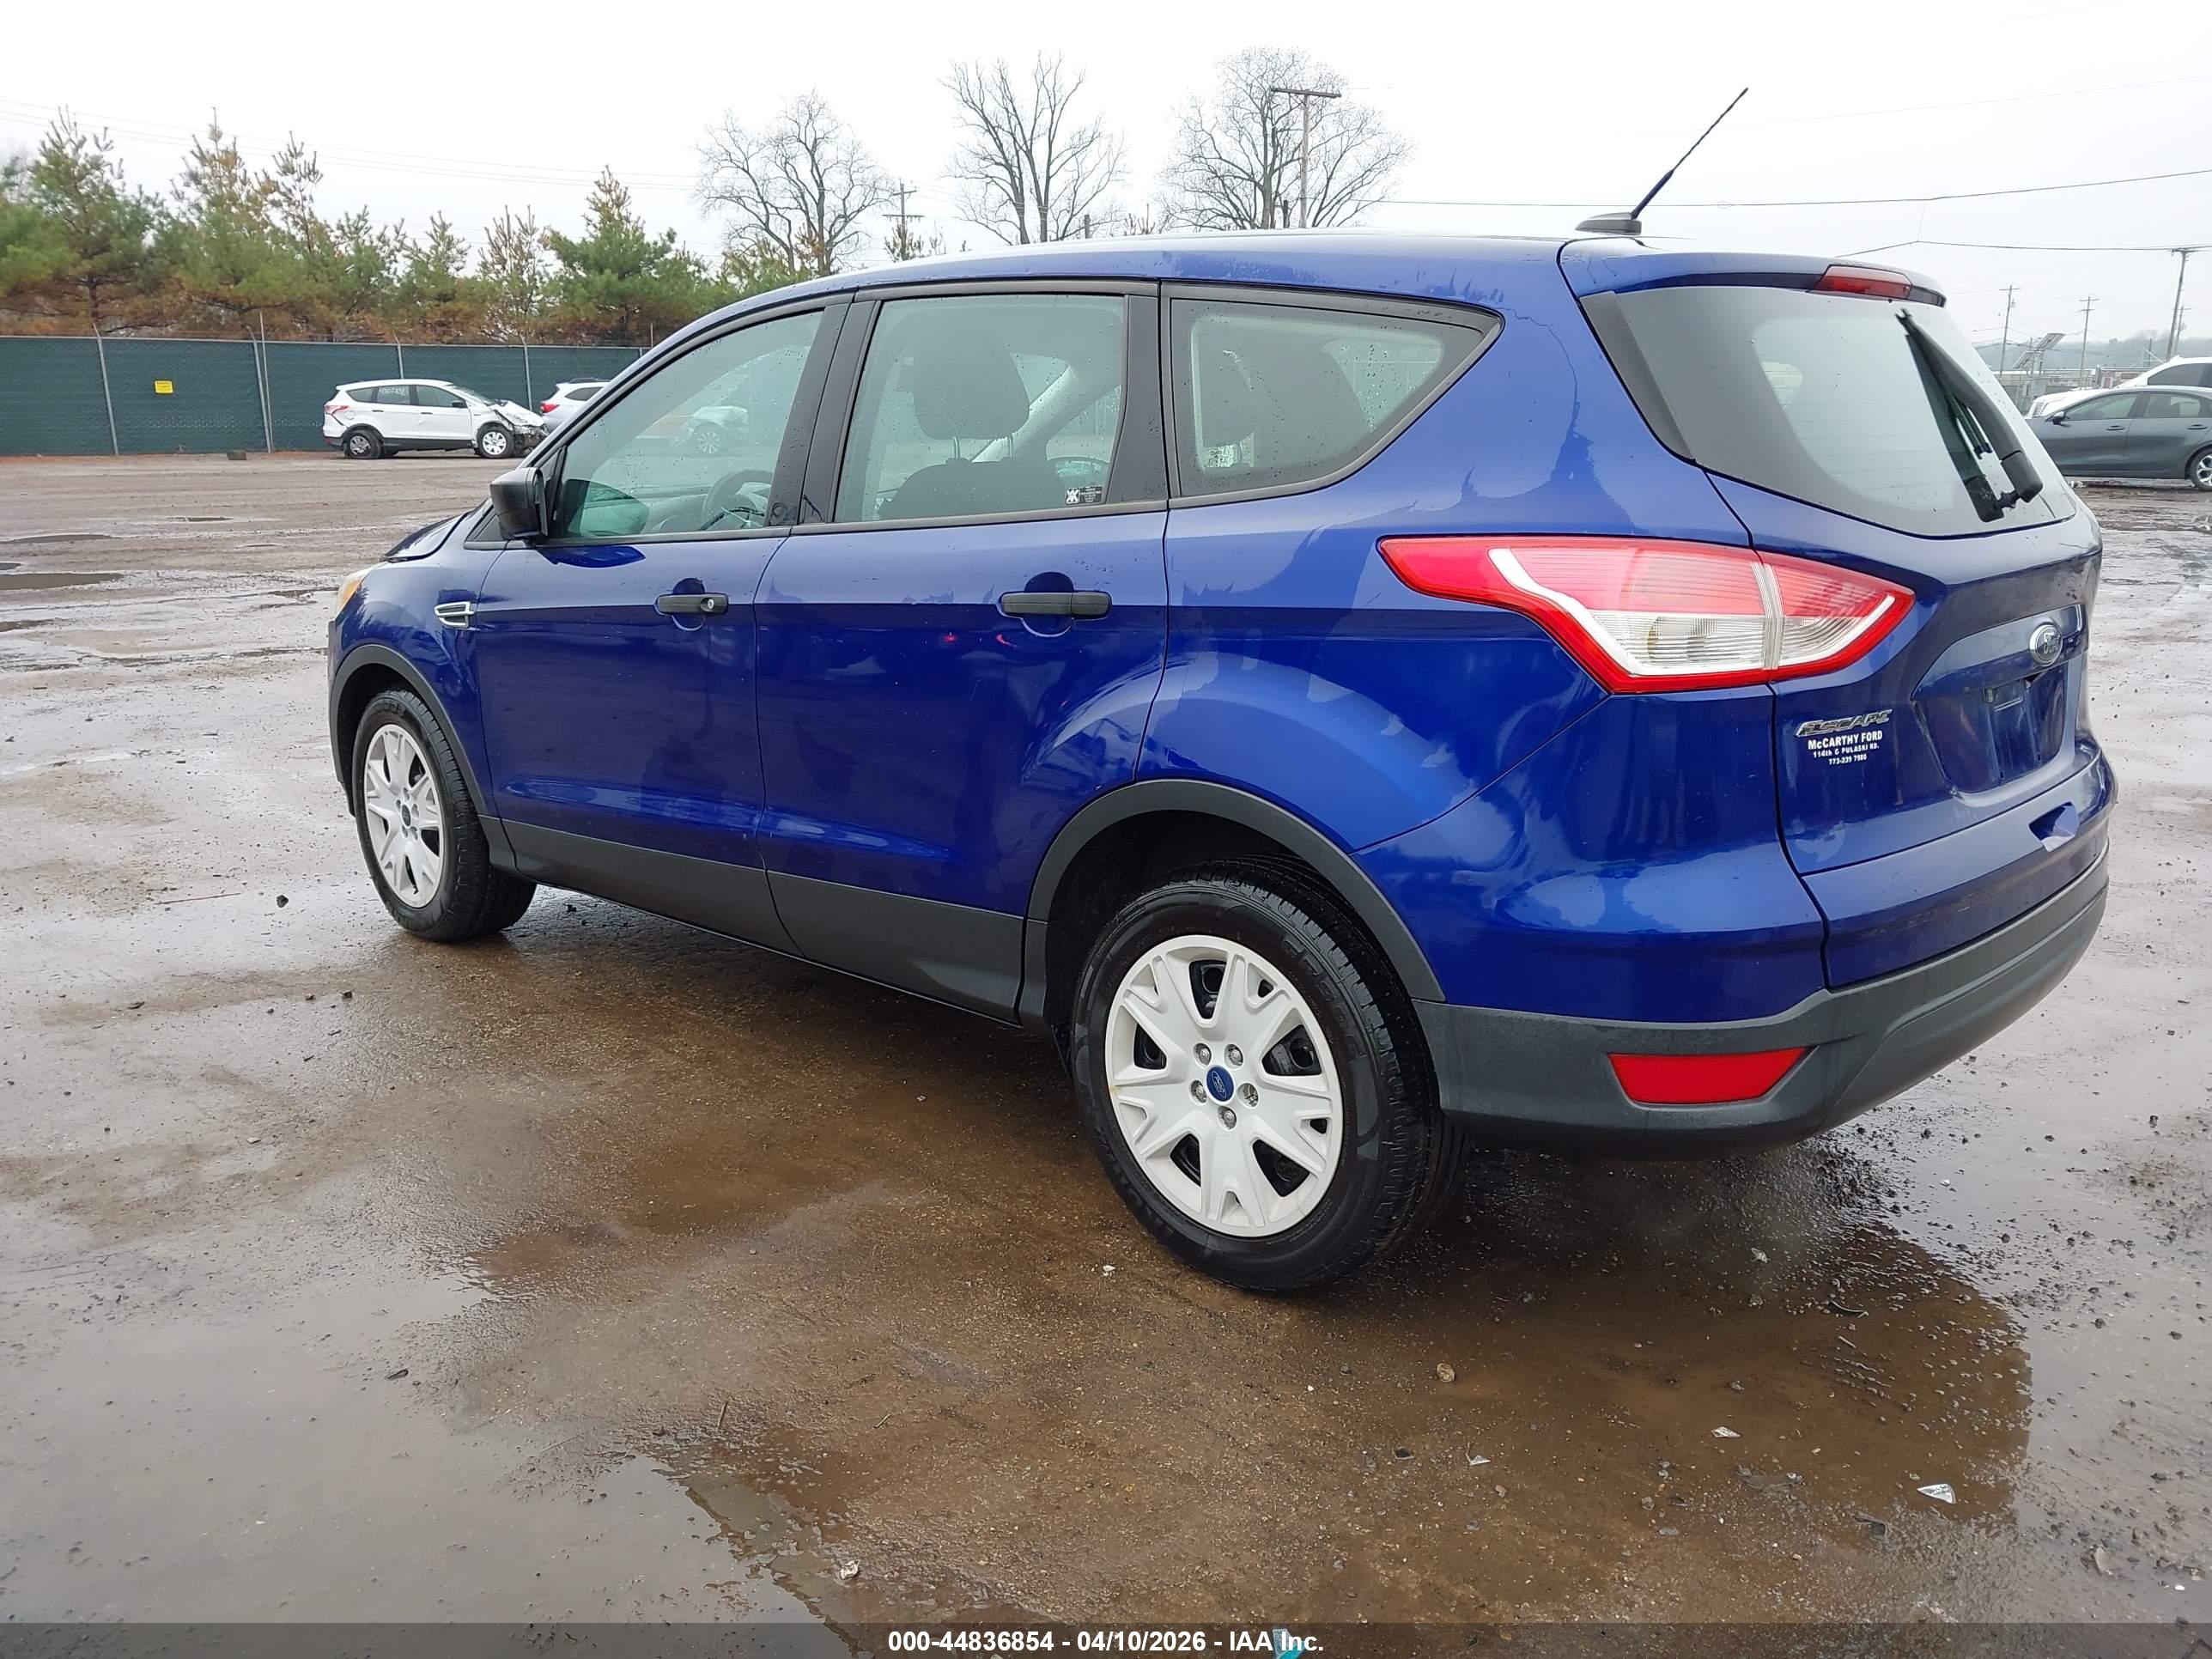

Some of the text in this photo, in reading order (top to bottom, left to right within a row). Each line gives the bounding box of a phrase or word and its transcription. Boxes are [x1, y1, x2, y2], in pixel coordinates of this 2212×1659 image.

[1796, 709, 1893, 737] ESCAPE
[1808, 731, 1883, 750] McCARTHY FORD
[1813, 749, 1832, 758] 114th
[1841, 744, 1869, 753] PULASKI
[1828, 755, 1852, 765] 773-239
